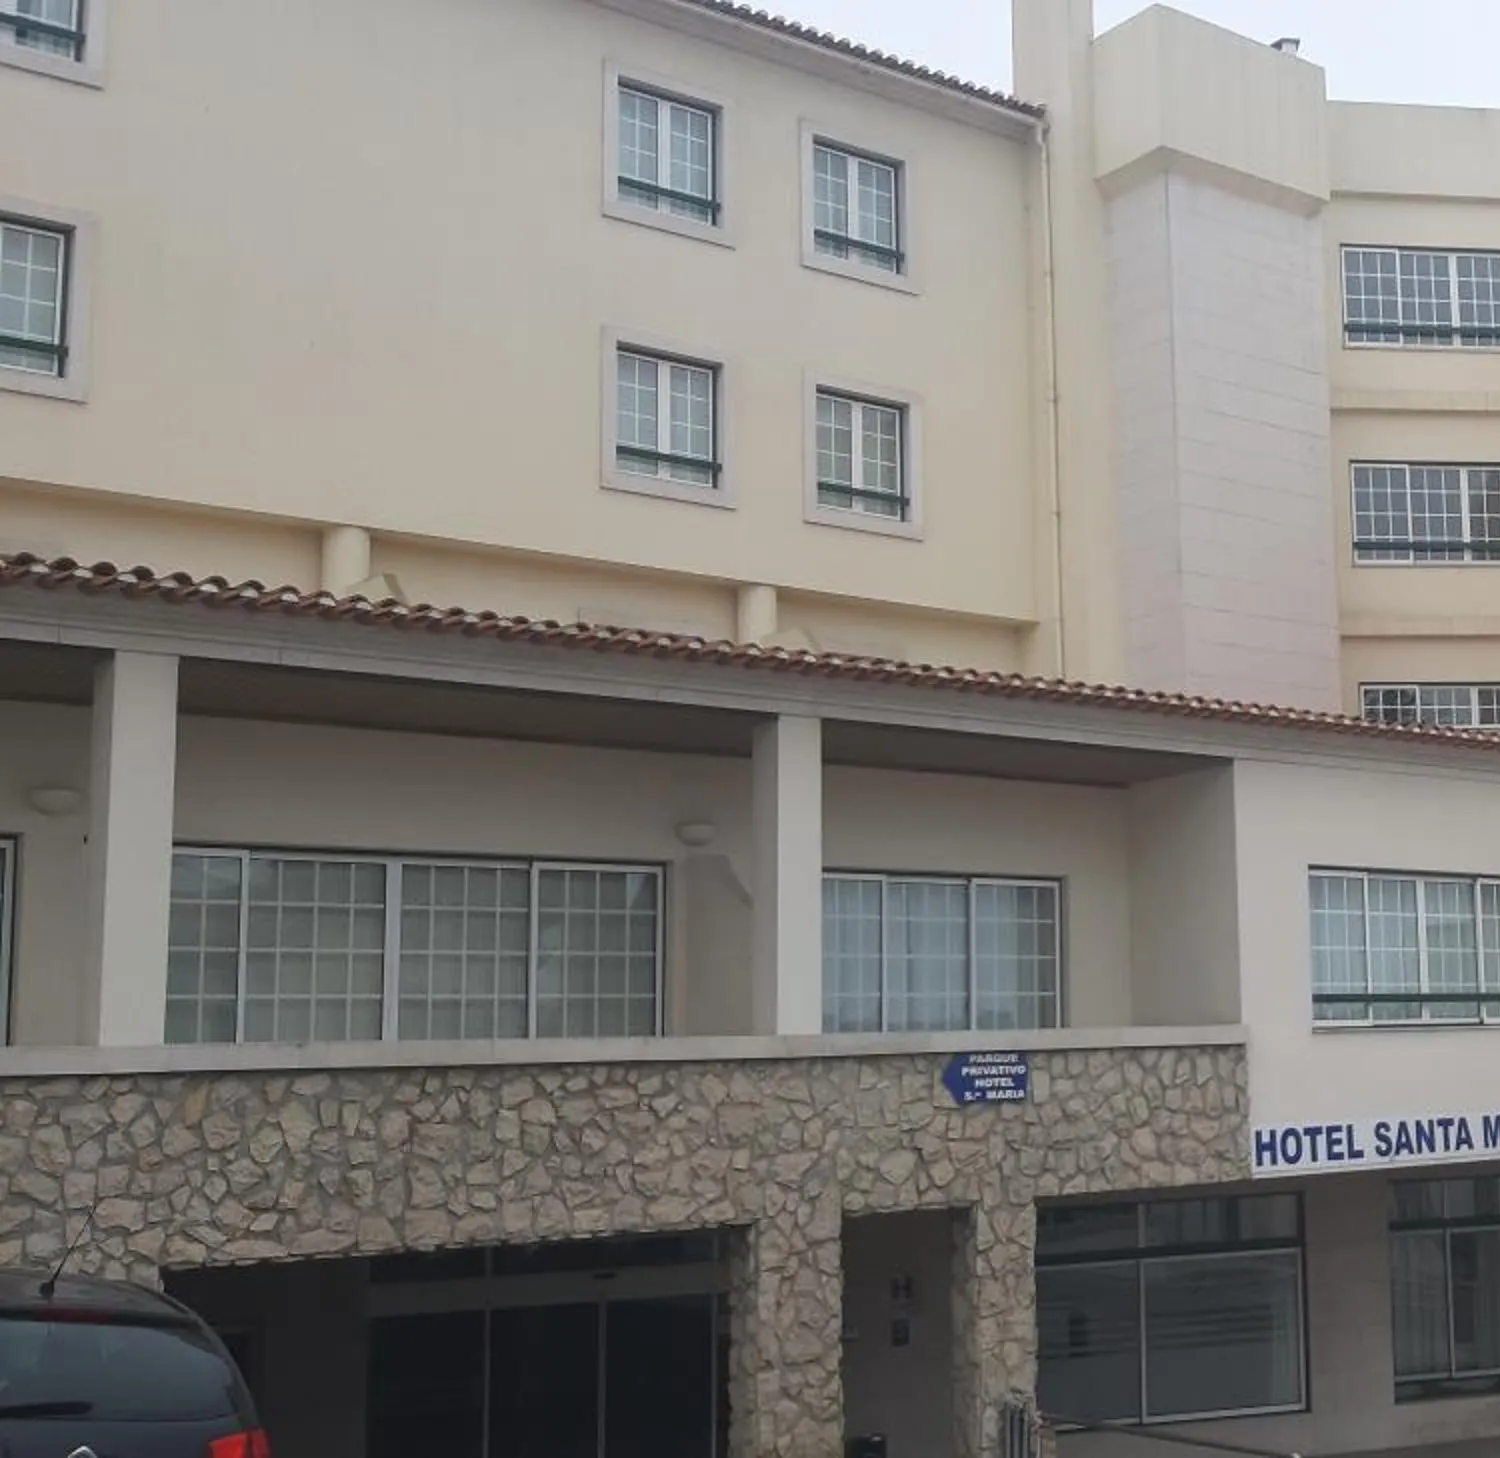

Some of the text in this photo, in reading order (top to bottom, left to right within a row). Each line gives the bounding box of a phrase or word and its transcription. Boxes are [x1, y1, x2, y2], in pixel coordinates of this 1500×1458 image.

[969, 1053, 1020, 1063] PARQUE
[961, 1065, 1026, 1076] PRIVATIVO
[975, 1078, 1015, 1087] HOTEL
[986, 1090, 1025, 1099] MARIA
[1254, 1124, 1365, 1167] HOTEL
[1374, 1116, 1474, 1157] SANTA
